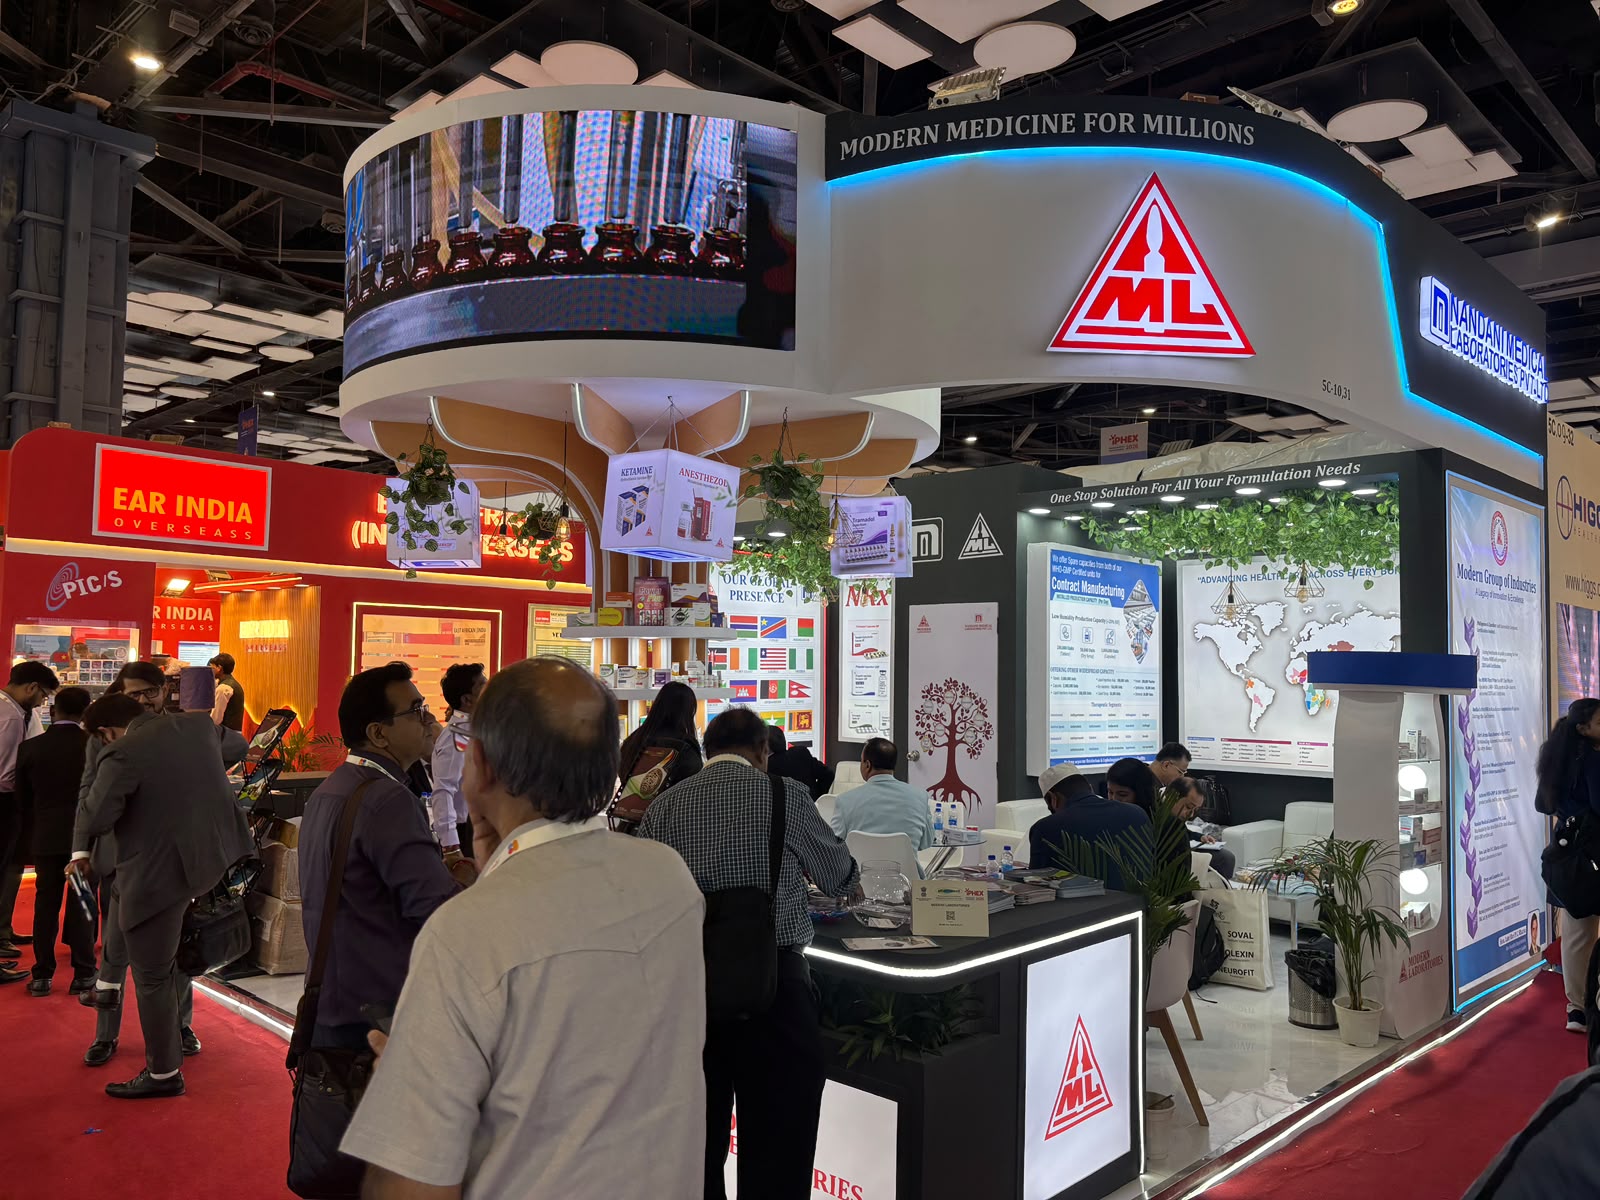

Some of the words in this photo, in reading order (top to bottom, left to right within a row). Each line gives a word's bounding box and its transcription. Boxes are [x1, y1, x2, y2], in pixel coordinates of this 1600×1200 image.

[840, 124, 940, 161] MODERN
[945, 112, 1076, 143] MEDICINE
[1083, 112, 1137, 134] FOR
[1142, 113, 1255, 146] MILLIONS
[620, 465, 654, 477] KETAMINE
[1050, 491, 1071, 504] One
[1073, 490, 1098, 504] Stop
[1100, 482, 1149, 499] Solution
[1151, 481, 1172, 494] For
[1173, 479, 1192, 492] All
[1194, 476, 1224, 490] Your
[1226, 467, 1312, 487] Formulation
[1315, 462, 1361, 478] Needs
[113, 487, 166, 515] EAR
[175, 494, 253, 524] INDIA
[114, 517, 253, 540] OVERSEASS
[1052, 576, 1080, 592] Contract
[1081, 580, 1125, 600] Manufacturing
[1457, 563, 1484, 583] Modern
[1484, 569, 1503, 590] Group
[1504, 574, 1511, 589] of
[1511, 575, 1537, 594] Industries
[729, 589, 785, 604] PRESENCE
[166, 605, 214, 622] INDIA
[1227, 930, 1254, 940] SOVAL
[1407, 954, 1444, 979] LABORATORIES
[1408, 949, 1431, 968] MODERN
